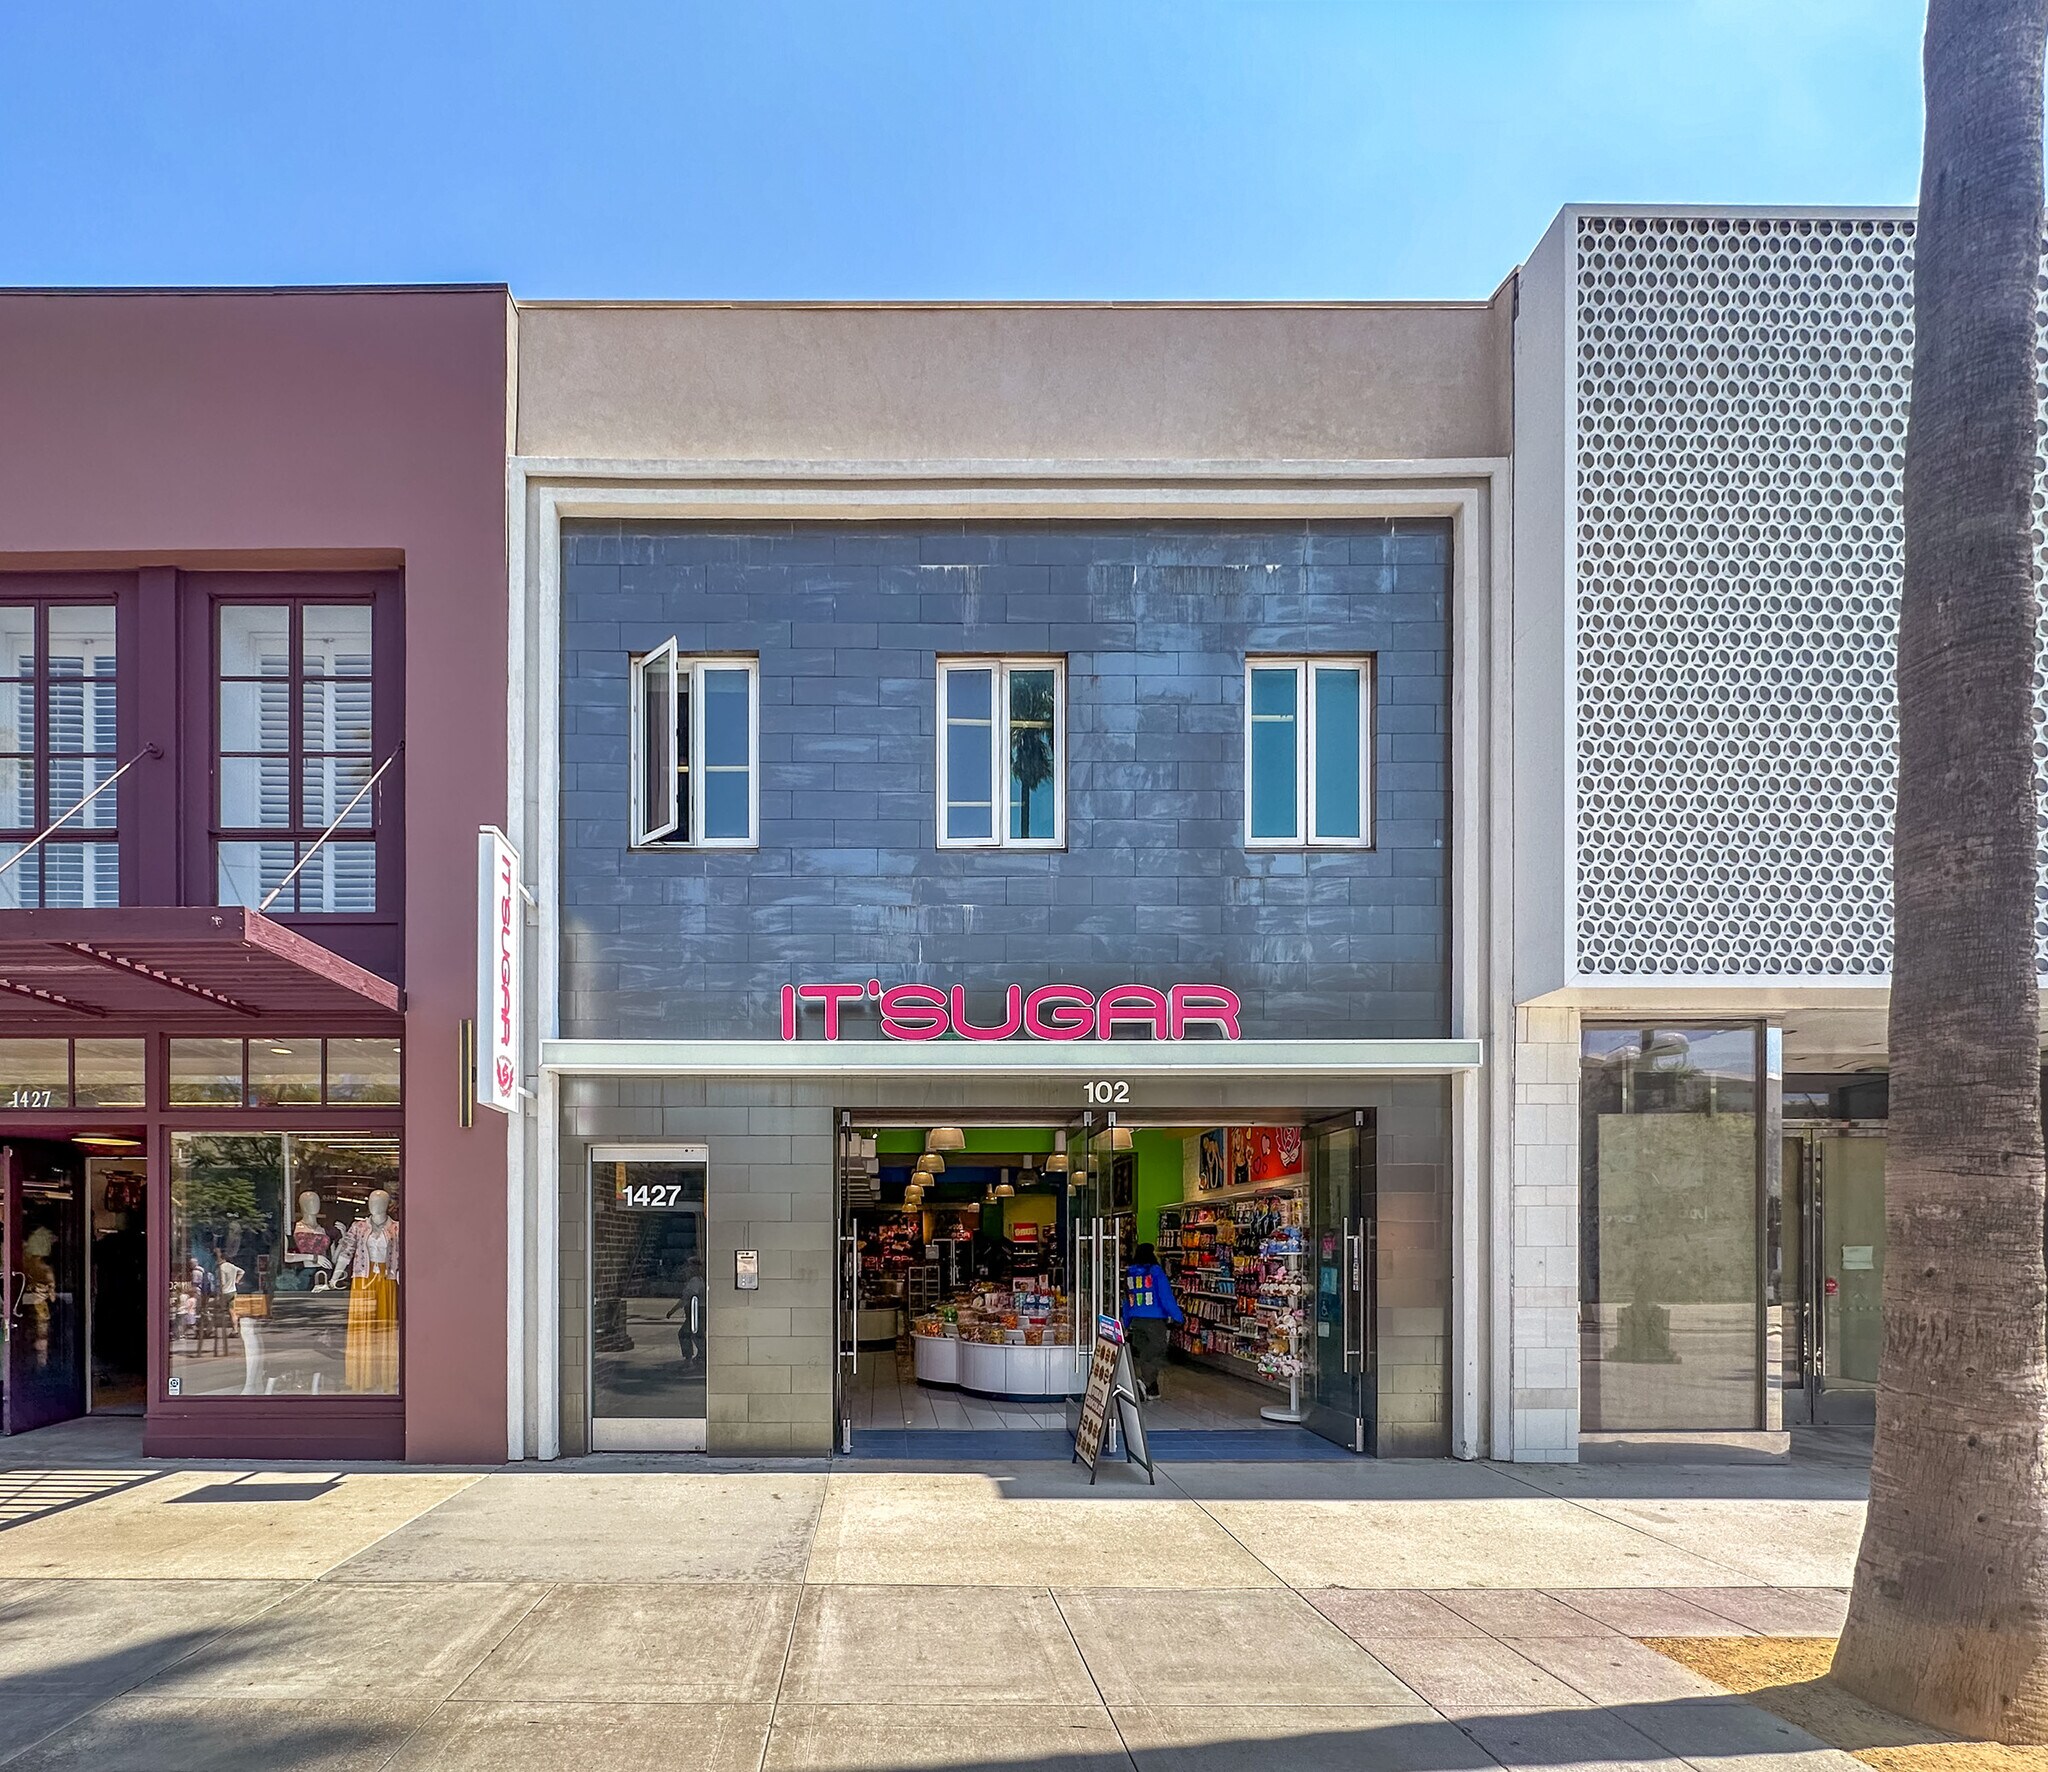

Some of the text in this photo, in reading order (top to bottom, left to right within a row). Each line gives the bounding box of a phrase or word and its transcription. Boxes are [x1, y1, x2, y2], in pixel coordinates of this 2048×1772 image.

[501, 854, 512, 1047] IT'SUGAR
[780, 978, 1242, 1042] IT'SUGAR
[12, 1090, 51, 1108] 1427
[1083, 1081, 1130, 1103] 102
[622, 1185, 682, 1207] 1427
